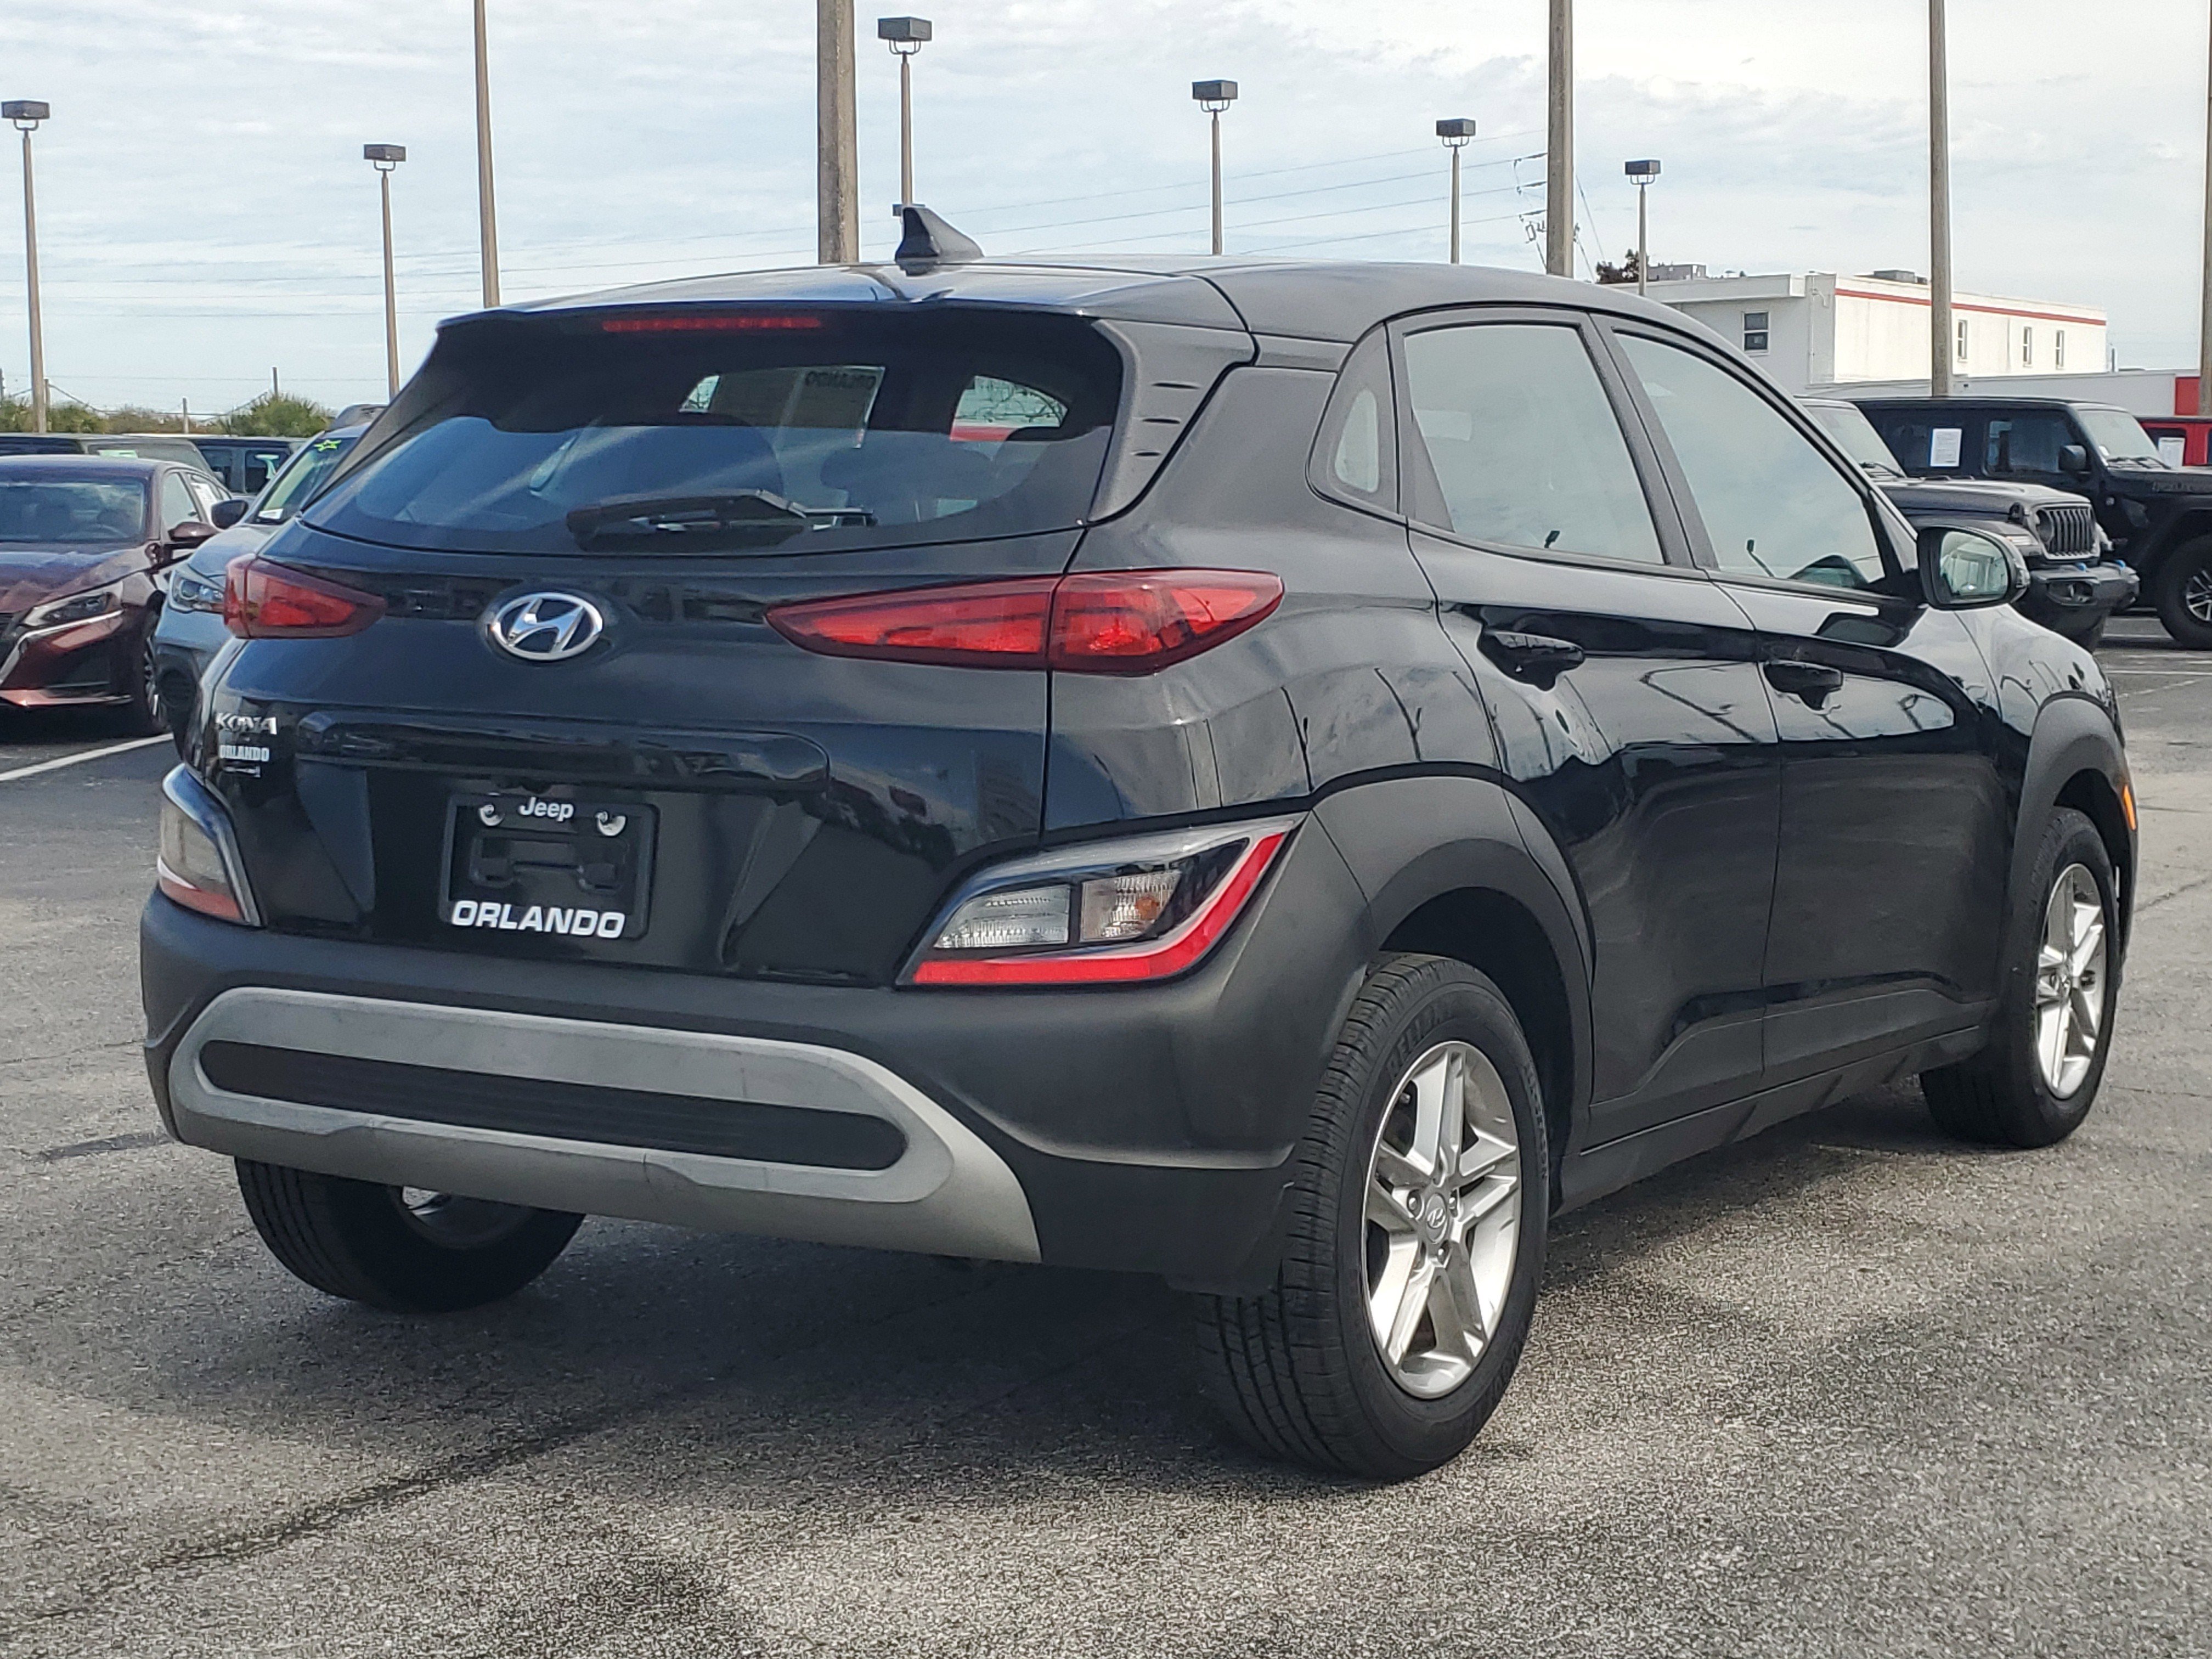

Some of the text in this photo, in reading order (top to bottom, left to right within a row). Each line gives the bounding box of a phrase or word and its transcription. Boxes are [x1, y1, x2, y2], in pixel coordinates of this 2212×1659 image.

[220, 744, 269, 762] ORLANDO
[519, 797, 574, 822] Jeep
[452, 900, 625, 939] ORLANDO
